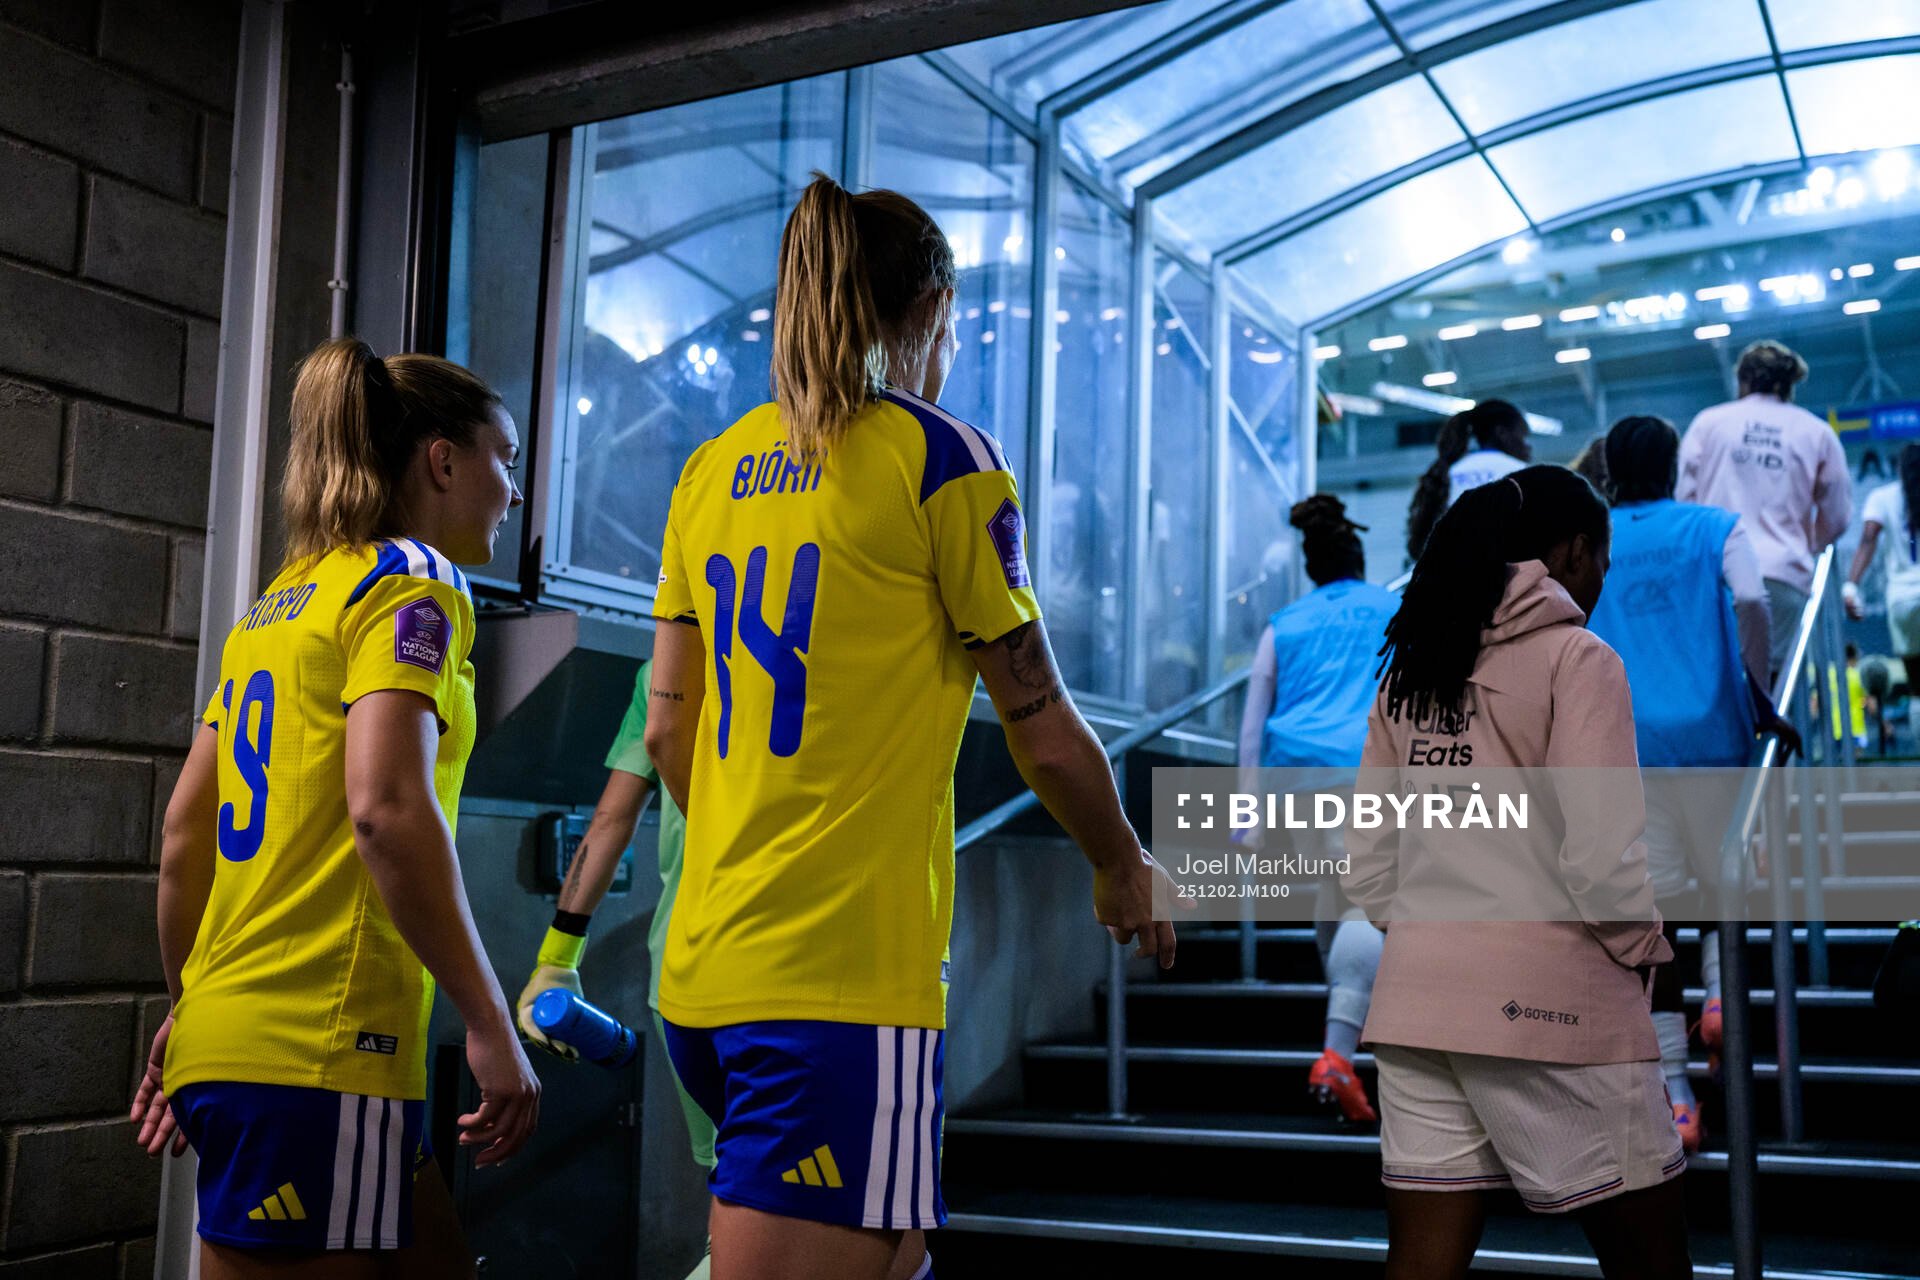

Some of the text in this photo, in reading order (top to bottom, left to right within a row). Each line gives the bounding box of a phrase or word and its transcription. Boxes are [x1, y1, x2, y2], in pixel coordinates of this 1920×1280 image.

[401, 640, 440, 659] NATIONS
[403, 647, 437, 664] LEAGUE
[705, 543, 820, 759] 14
[1408, 738, 1474, 767] Eats
[1524, 1007, 1580, 1026] GORE-TEX
